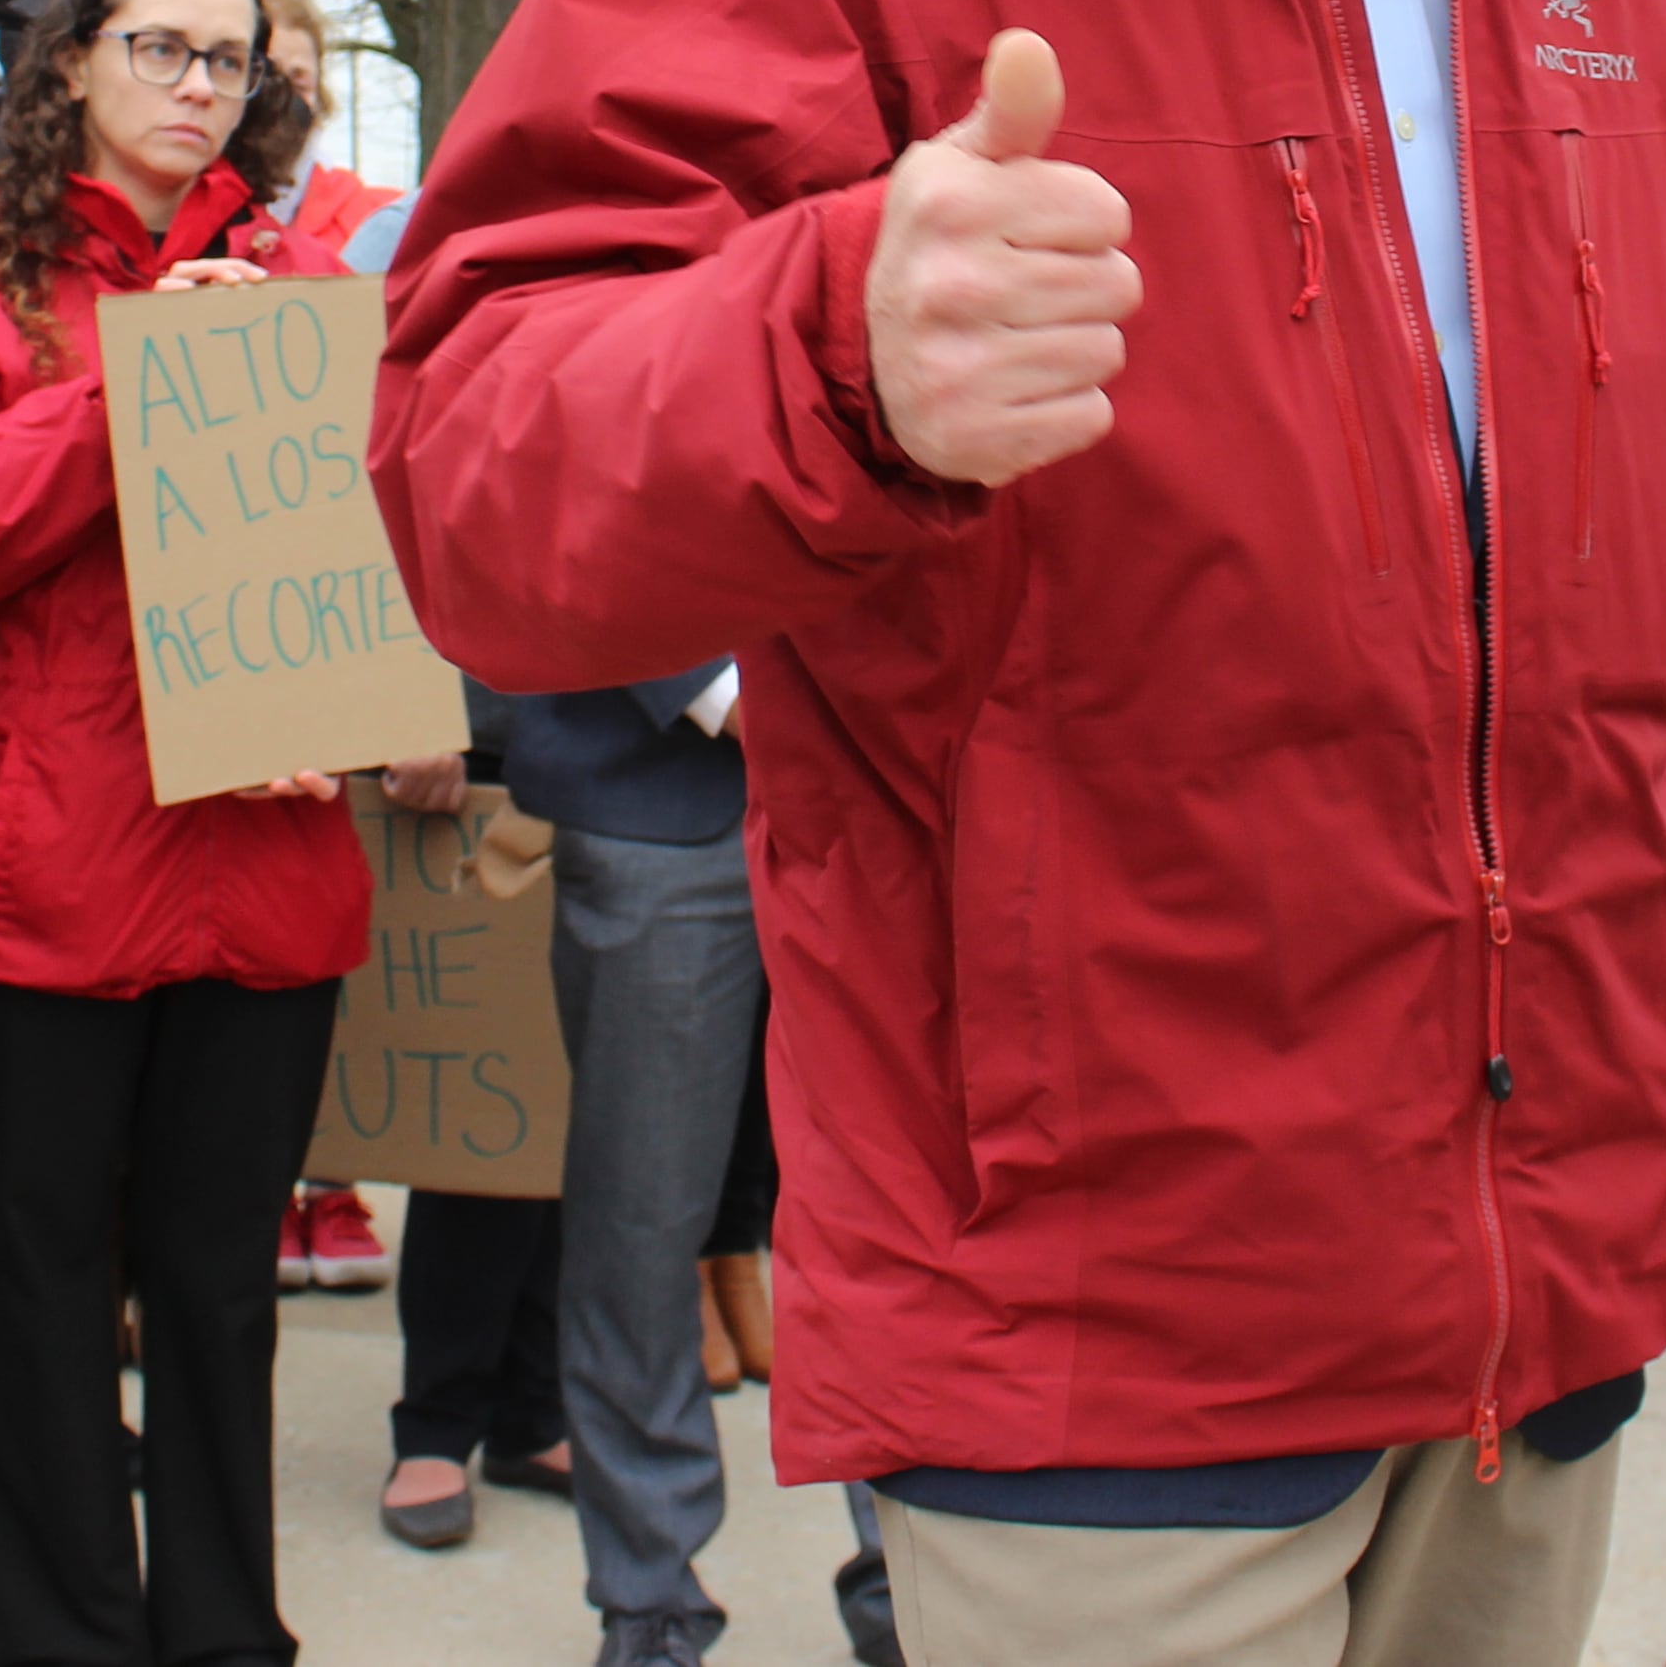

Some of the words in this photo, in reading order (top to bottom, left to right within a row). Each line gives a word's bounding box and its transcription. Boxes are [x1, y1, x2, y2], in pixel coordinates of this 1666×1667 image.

[139, 298, 328, 449] ALTO
[154, 465, 207, 552] A
[226, 423, 359, 523] LOS
[144, 563, 434, 695] RECORTE
[313, 1048, 529, 1158] UTS
